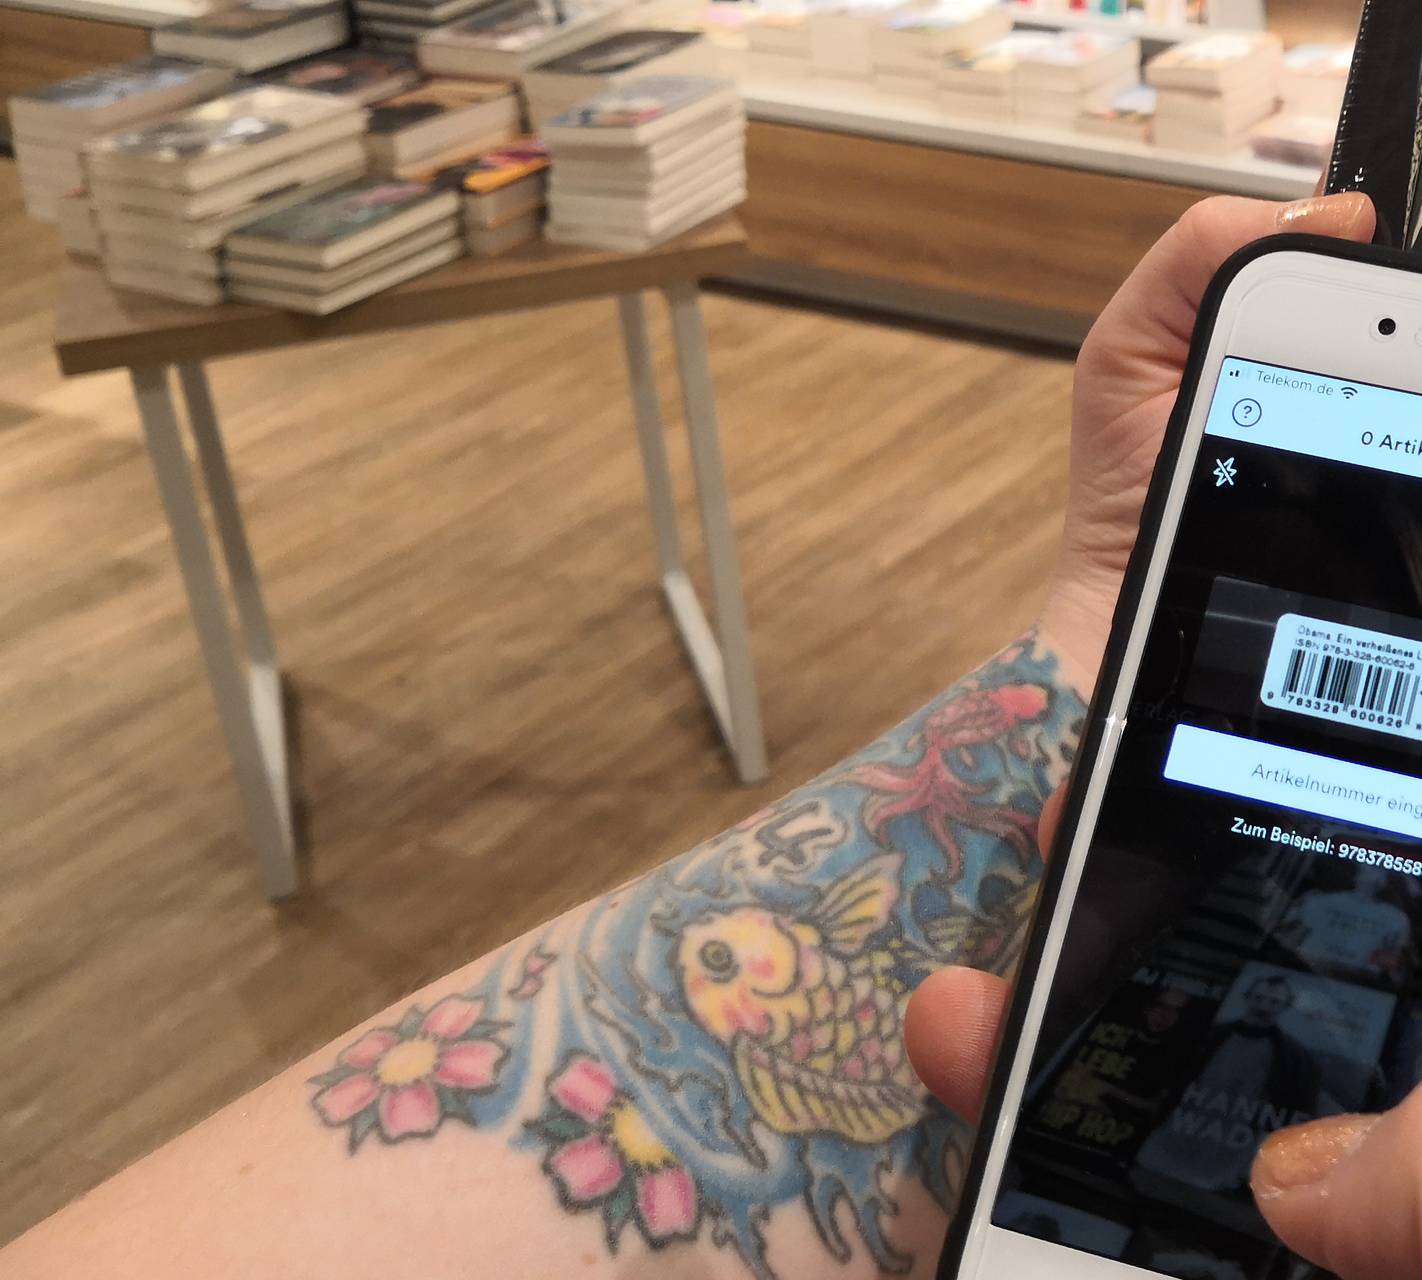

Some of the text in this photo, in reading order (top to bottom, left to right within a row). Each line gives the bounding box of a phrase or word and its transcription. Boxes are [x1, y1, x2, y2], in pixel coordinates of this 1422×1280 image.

[1256, 369, 1333, 397] Telekom.de
[1361, 430, 1374, 447] 0
[1252, 763, 1382, 806] Artikelnummer
[1231, 817, 1266, 838] Zum
[1270, 825, 1335, 856] Beispiel:
